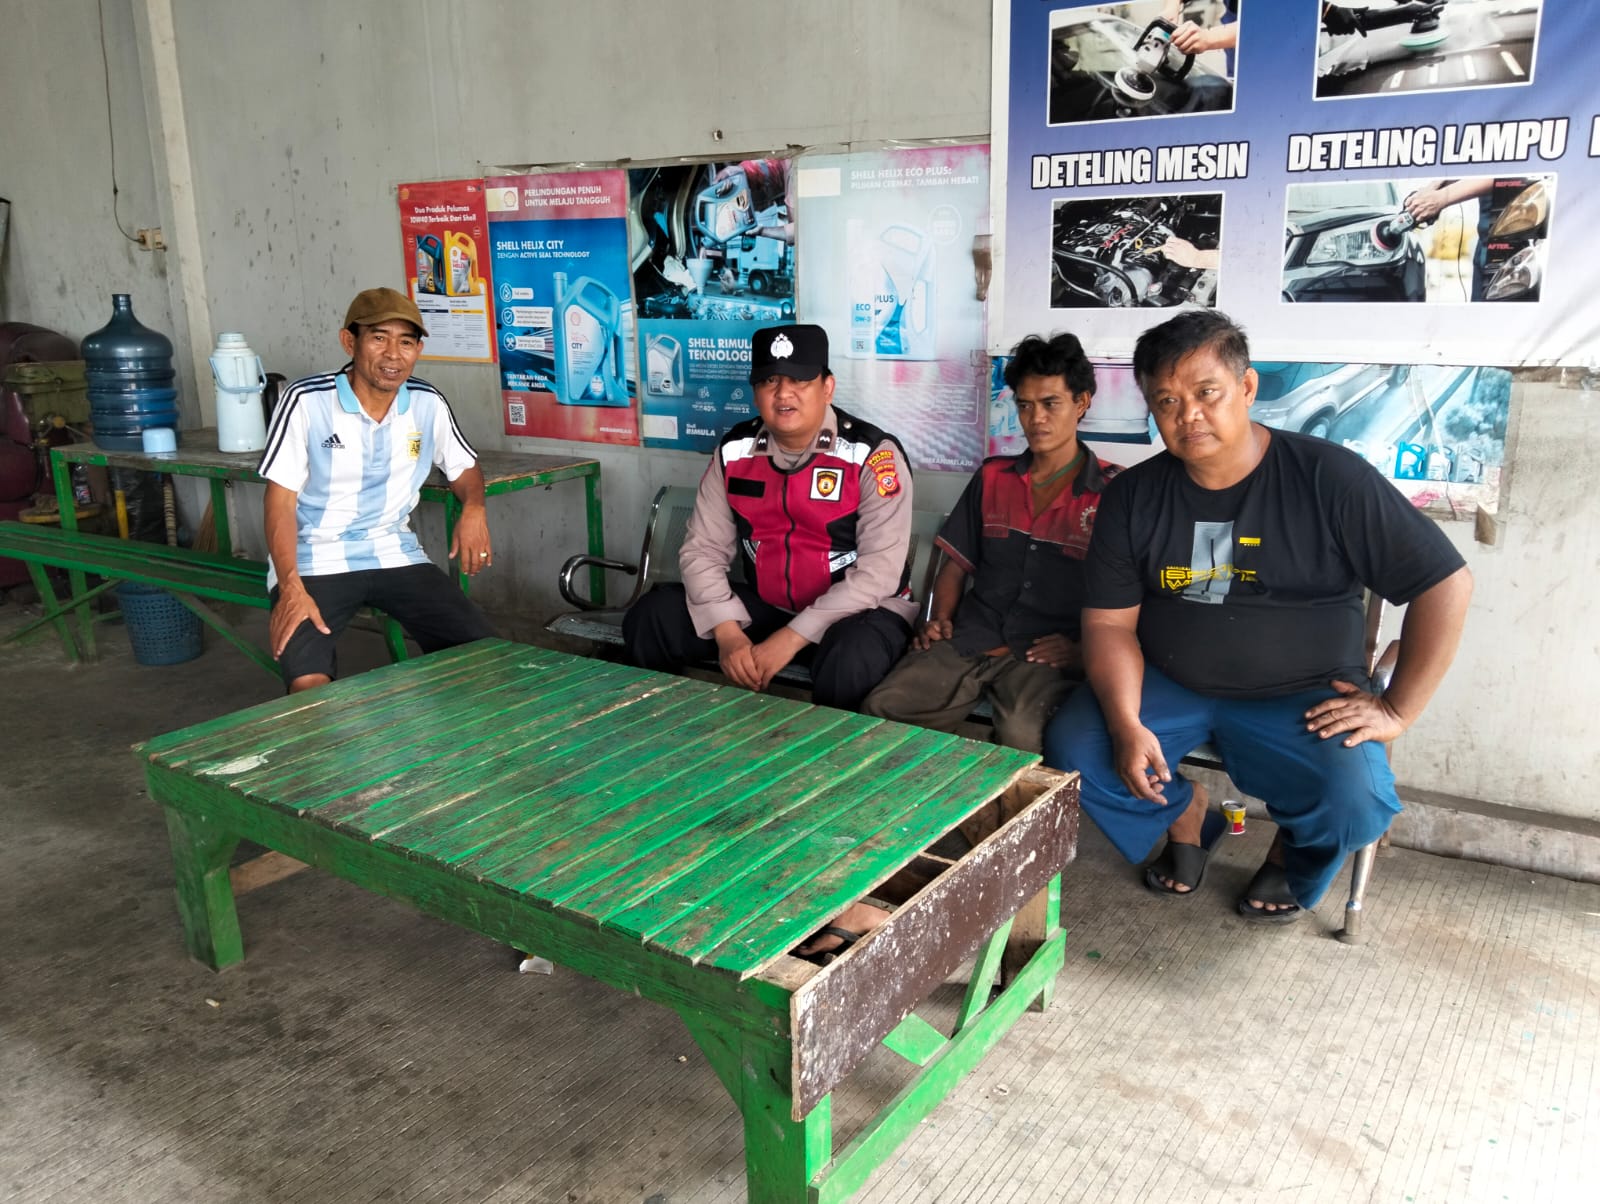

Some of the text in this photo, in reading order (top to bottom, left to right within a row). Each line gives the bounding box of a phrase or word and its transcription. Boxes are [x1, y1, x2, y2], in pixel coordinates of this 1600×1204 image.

[1287, 125, 1438, 172] DETELING
[1441, 118, 1570, 165] LAMPU
[1032, 141, 1249, 189] DETELING MESIN
[851, 166, 952, 180] SHELL HELIX ECO PLUS:
[524, 186, 602, 197] PERLINDUNGAN PENUH
[525, 196, 611, 207] UNTUK MELAJU TANGGUH
[426, 205, 445, 213] Produk
[446, 204, 469, 212] Pelumas
[428, 215, 449, 223] Terbaik
[450, 214, 462, 222] Dari
[462, 213, 477, 221] Shell
[496, 240, 564, 250] SHELL HELIX CITY
[855, 303, 871, 311] ECO
[688, 338, 715, 348] SHELL
[688, 349, 752, 362] TEKNOLOGI
[686, 428, 716, 437] RIMULA
